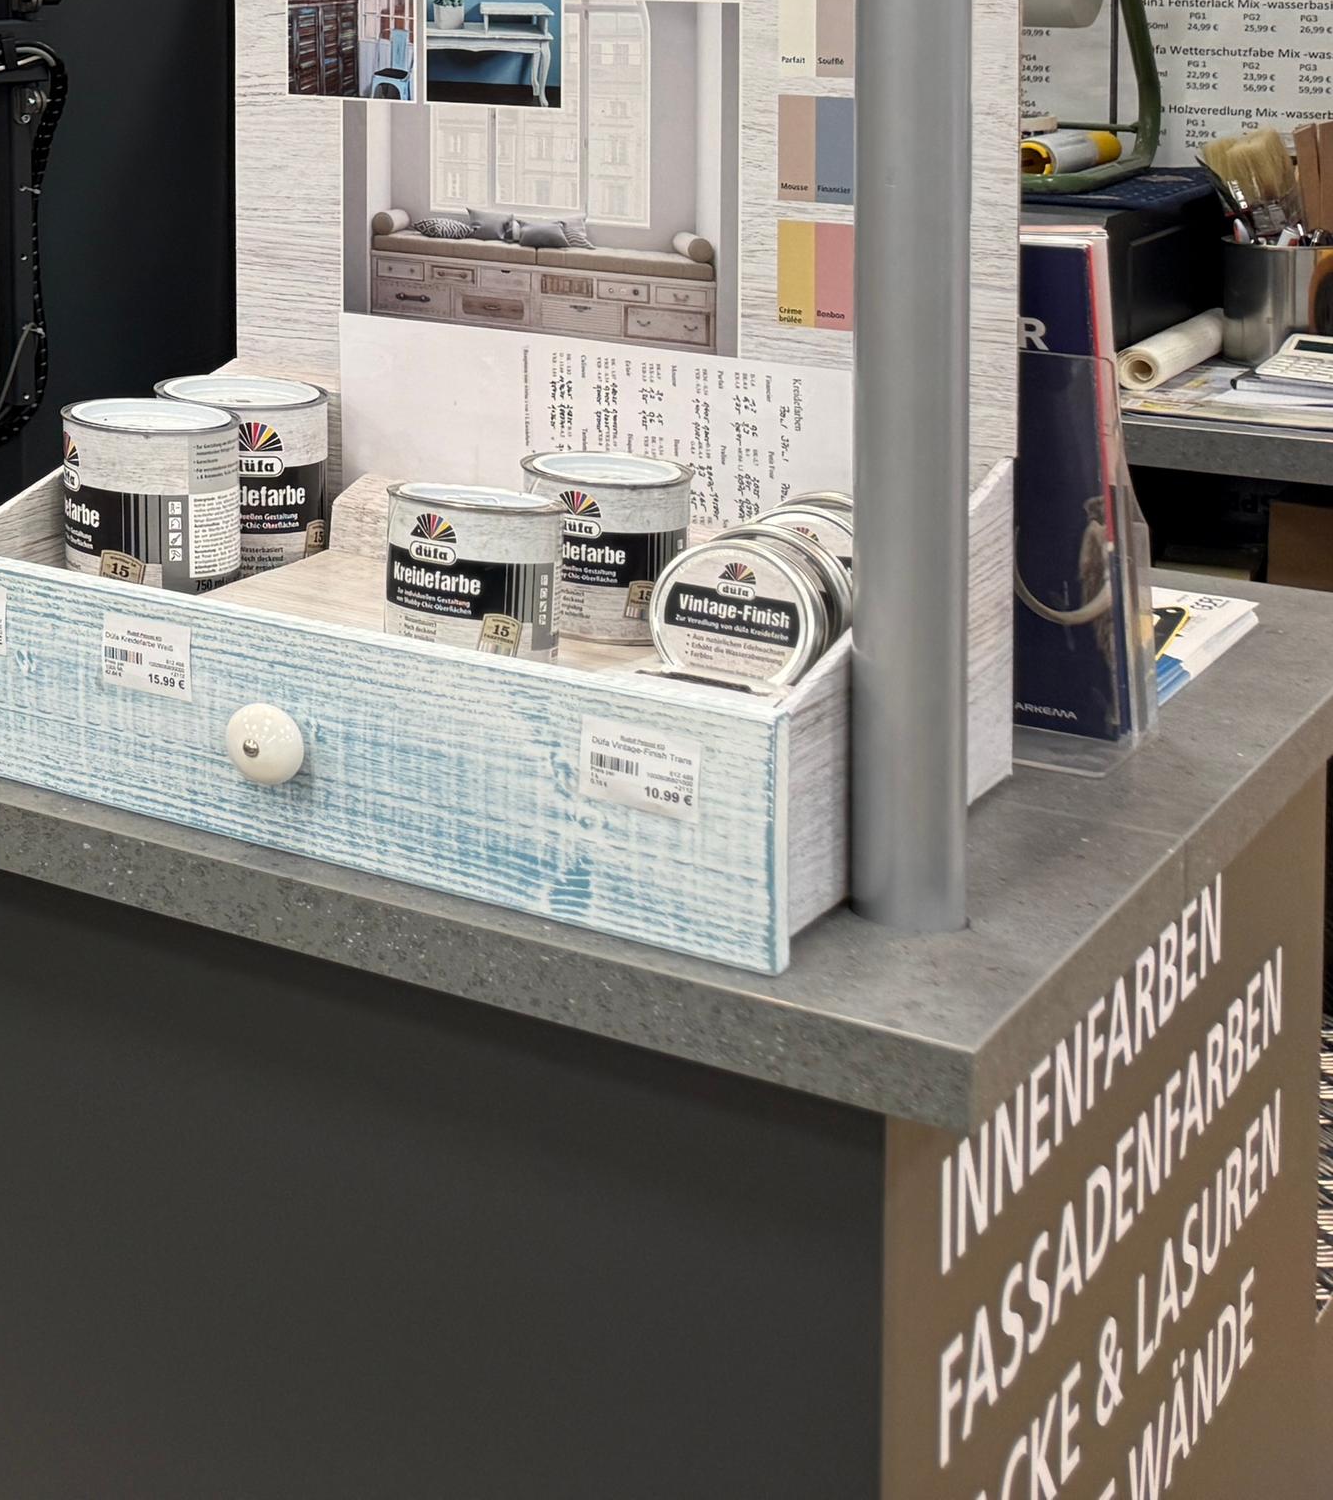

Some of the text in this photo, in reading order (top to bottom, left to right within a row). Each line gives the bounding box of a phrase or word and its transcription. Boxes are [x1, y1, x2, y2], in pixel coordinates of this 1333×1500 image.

[1238, 0, 1259, 8] Mix
[781, 55, 844, 65] Parfait Soufflé
[1278, 48, 1300, 58] Mix
[1169, 104, 1277, 118] Holzveredlung Mix
[781, 183, 851, 194] Mousse Financier
[779, 305, 802, 315] Crème
[816, 310, 845, 319] Bonbon
[779, 315, 802, 324] brûlée
[792, 378, 802, 432] Kreidefarben
[239, 485, 305, 507] defarbe
[415, 545, 448, 561] düfa
[562, 541, 626, 565] defarbe
[110, 561, 130, 578] 15
[196, 578, 212, 591] 750
[393, 561, 481, 596] Kreidefarbe
[722, 585, 749, 597] düfa
[679, 593, 790, 629] Vintage-Finish
[493, 624, 510, 638] 15
[148, 673, 185, 689] 15.99 €
[1015, 701, 1078, 721] ARKEMA
[645, 785, 693, 806] 10.99 €
[941, 872, 1223, 1276] INNENFARBEN
[939, 945, 1283, 1469] FASSADENFARBEN
[1096, 1316, 1124, 1427] &
[1137, 1086, 1282, 1375] LASUREN
